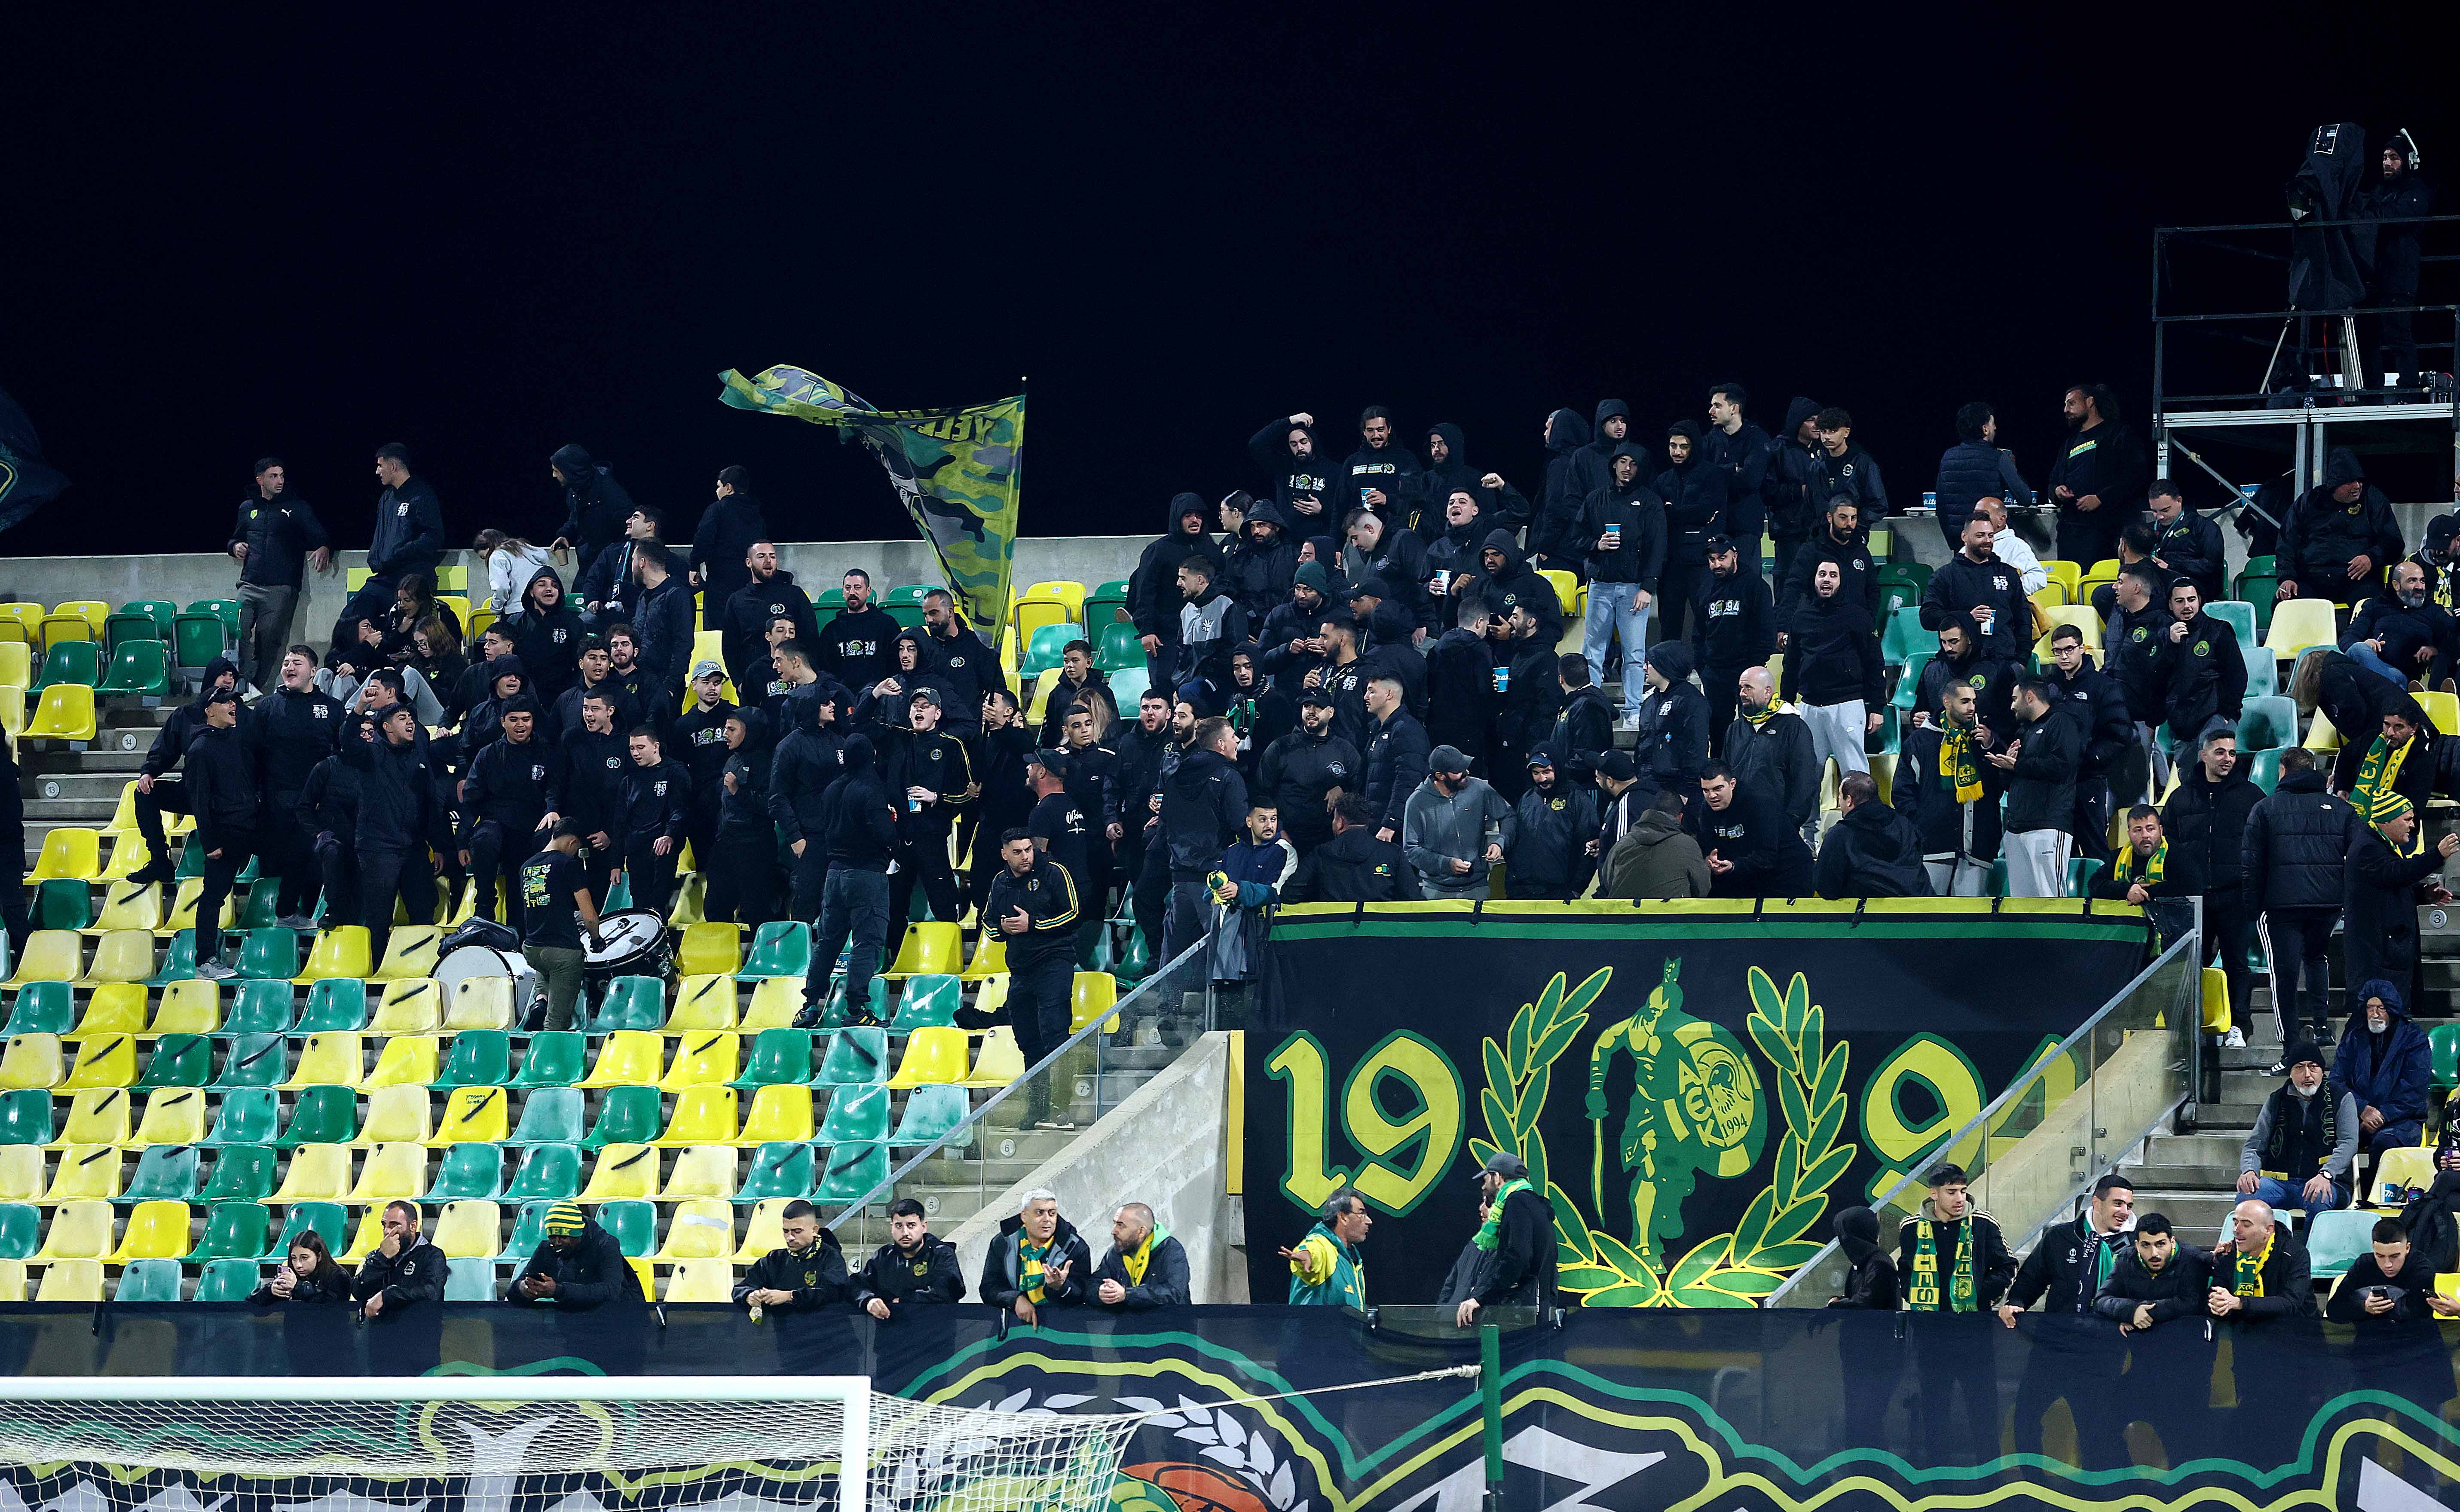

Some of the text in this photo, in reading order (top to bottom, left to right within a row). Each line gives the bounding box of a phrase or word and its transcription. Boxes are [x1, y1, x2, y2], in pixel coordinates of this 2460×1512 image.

[1726, 601, 1740, 612] 94
[2434, 914, 2441, 923] 3
[1264, 1029, 1466, 1217] 19
[1721, 1113, 1748, 1138] 1994
[929, 1201, 933, 1210] 5
[853, 1259, 860, 1270] 4
